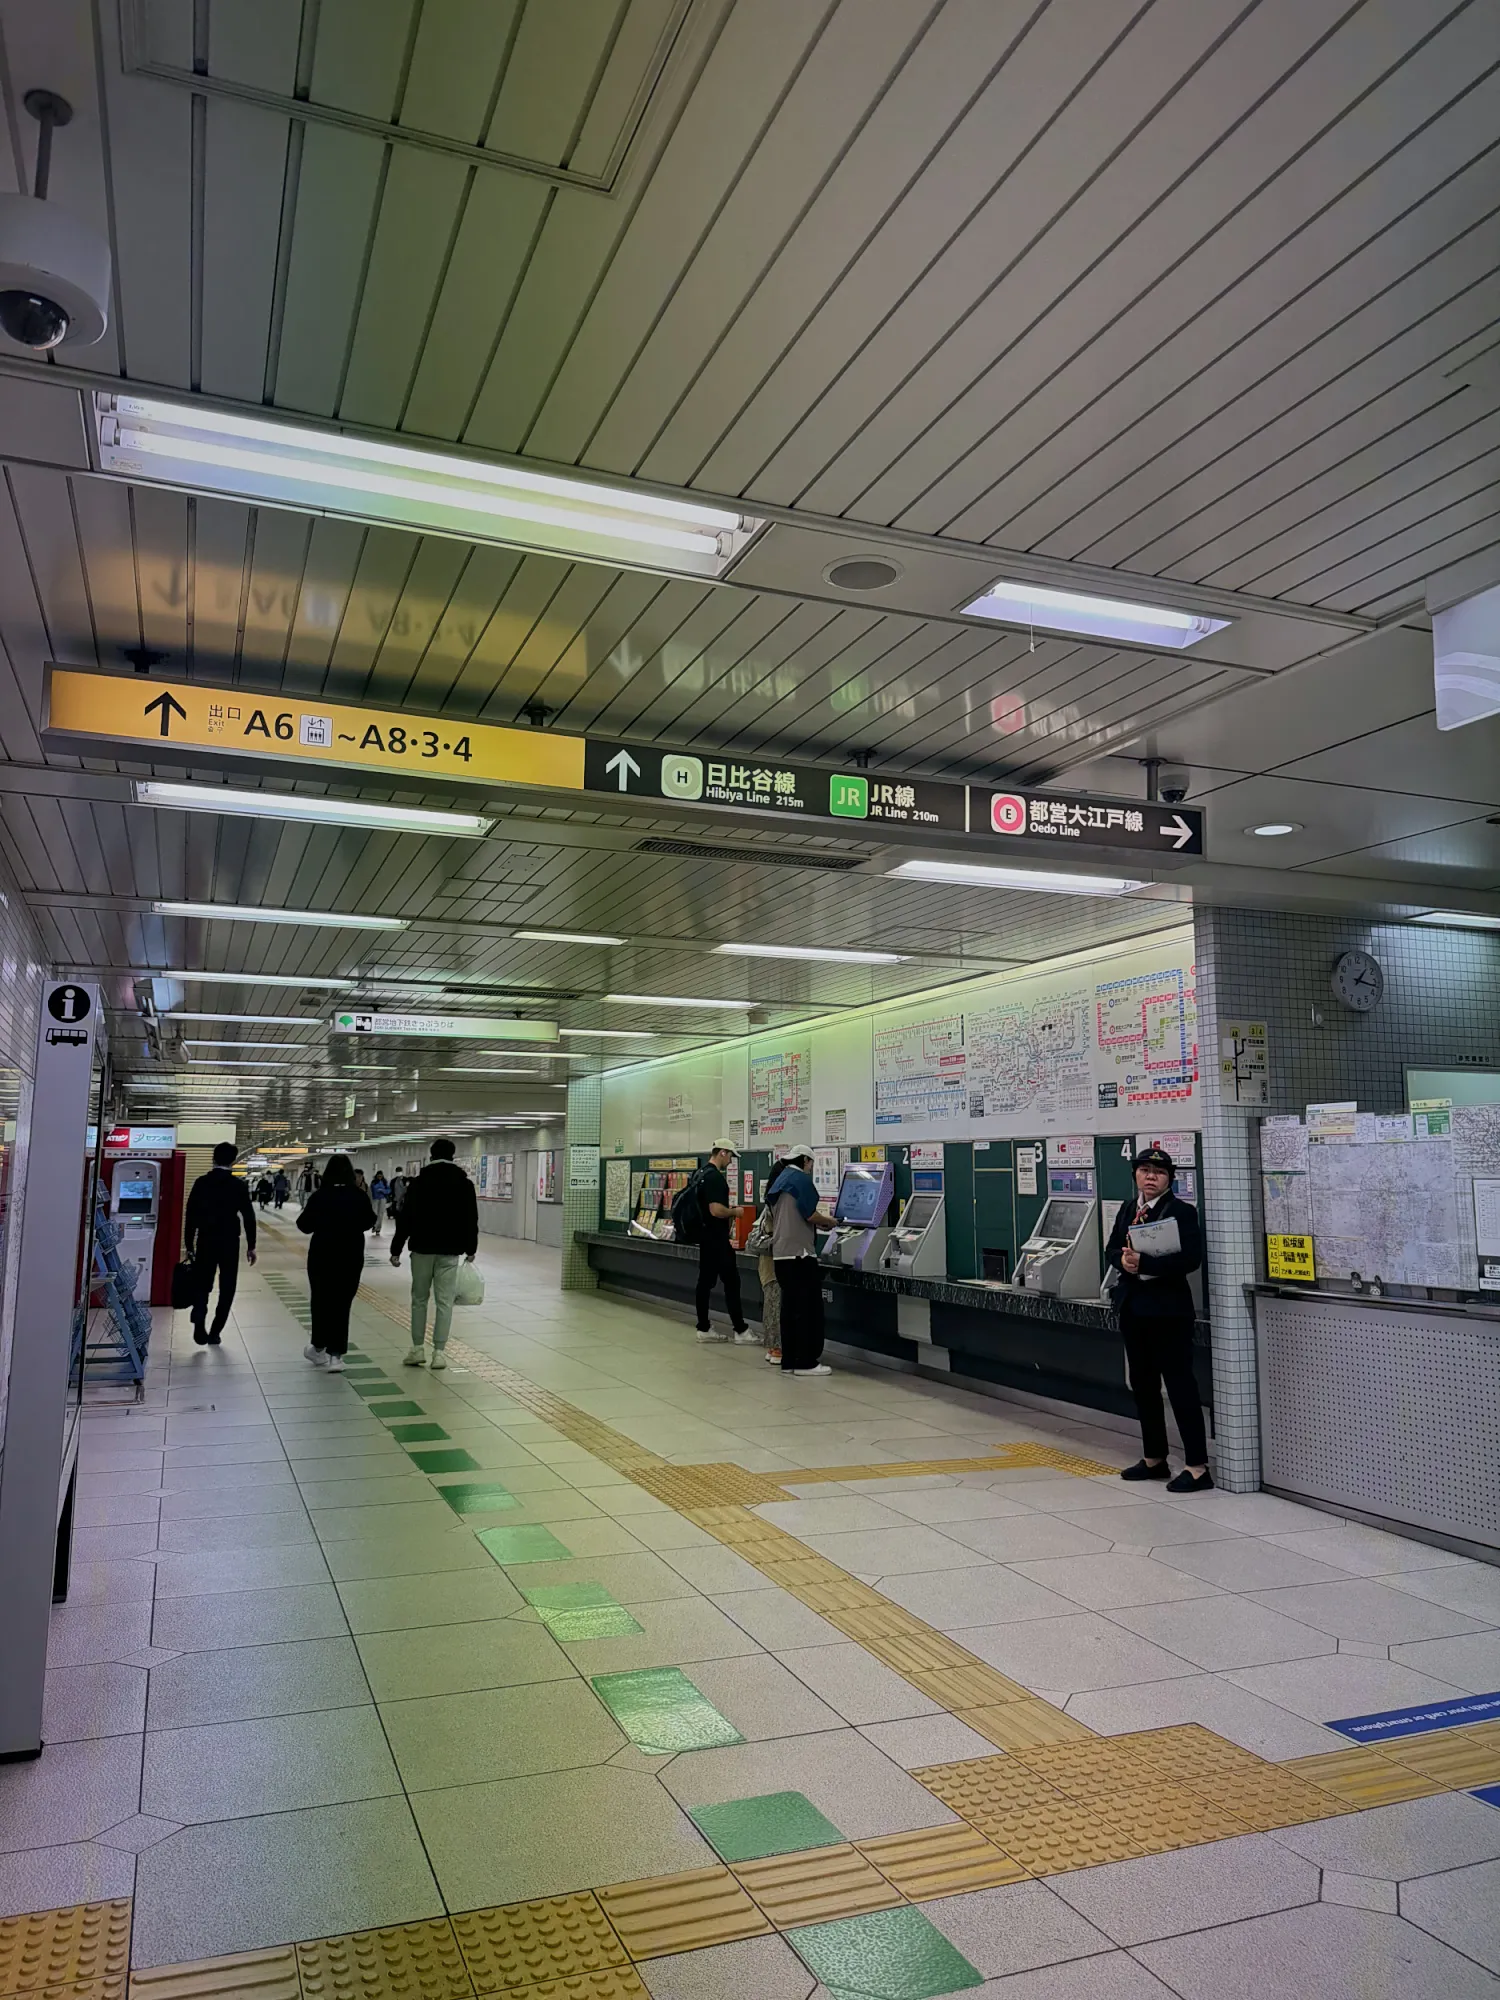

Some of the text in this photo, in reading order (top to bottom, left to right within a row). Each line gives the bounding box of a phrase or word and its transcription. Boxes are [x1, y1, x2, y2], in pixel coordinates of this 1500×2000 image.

[209, 704, 241, 720] 出口
[208, 718, 225, 727] Exit
[243, 709, 294, 740] A6
[676, 770, 688, 784] H
[707, 763, 796, 795] 日比谷線
[706, 786, 804, 808] Hibiya Line 215m
[837, 786, 860, 807] JR
[870, 784, 915, 808] JR線
[870, 804, 939, 823] JR Line 210m
[1005, 808, 1012, 820] E
[1029, 800, 1144, 833] 都営大江戸線
[1029, 822, 1081, 838] Oedo Line
[902, 1147, 909, 1165] 2
[1035, 1141, 1043, 1163] 3
[1121, 1138, 1132, 1161] 4
[768, 1153, 772, 1166] 1
[1269, 1237, 1277, 1246] A2
[1414, 1714, 1424, 1722] or
[1424, 1711, 1447, 1720] card
[1348, 1718, 1413, 1732] smartphone.
